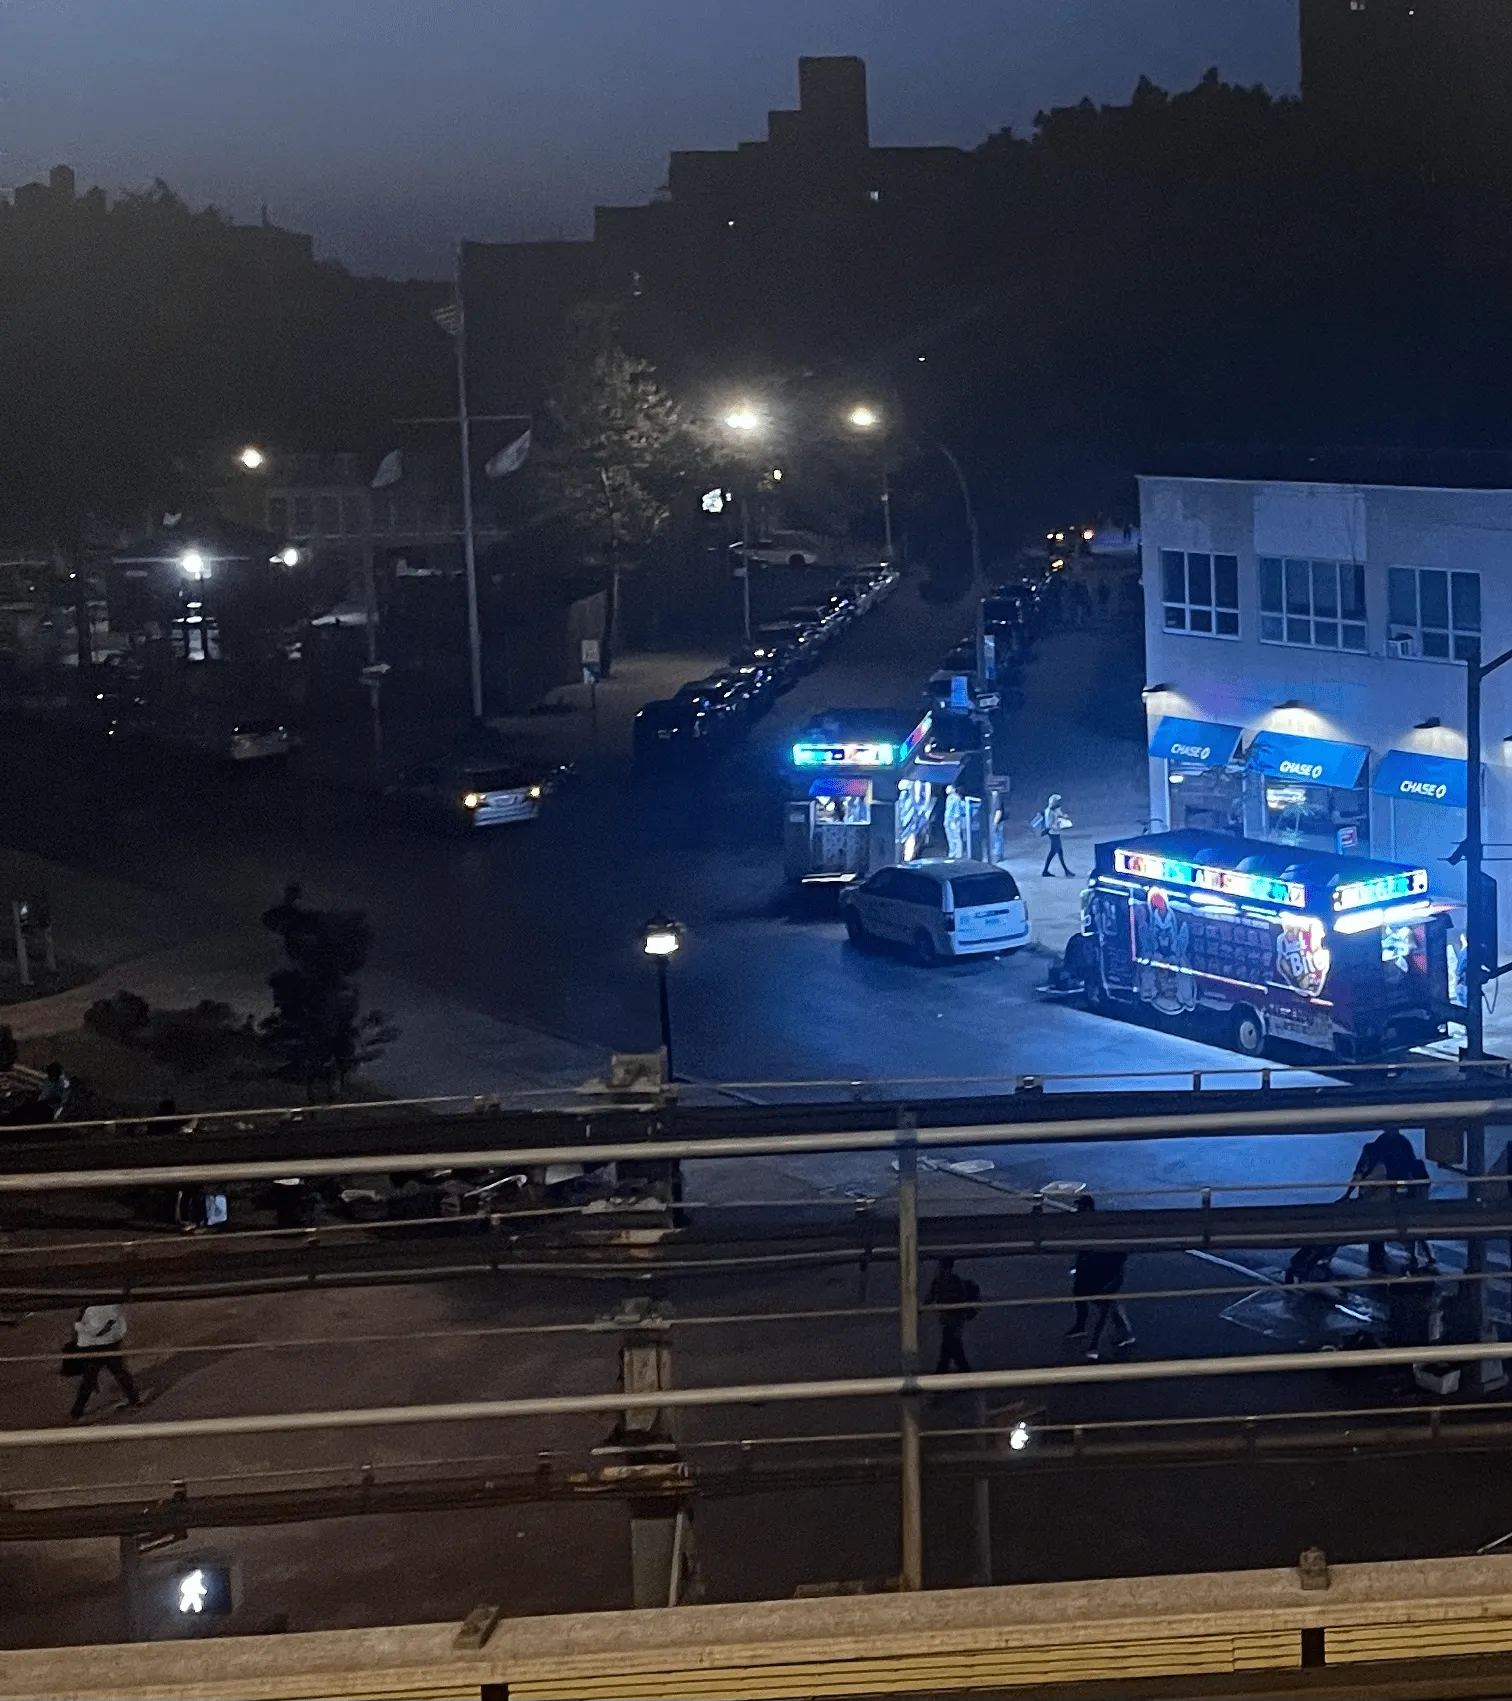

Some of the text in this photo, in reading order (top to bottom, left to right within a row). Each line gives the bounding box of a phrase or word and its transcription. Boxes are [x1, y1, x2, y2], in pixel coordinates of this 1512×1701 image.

[1171, 743, 1201, 758] CHASE
[1279, 760, 1313, 777] CHASE
[1400, 780, 1437, 796] CHASE
